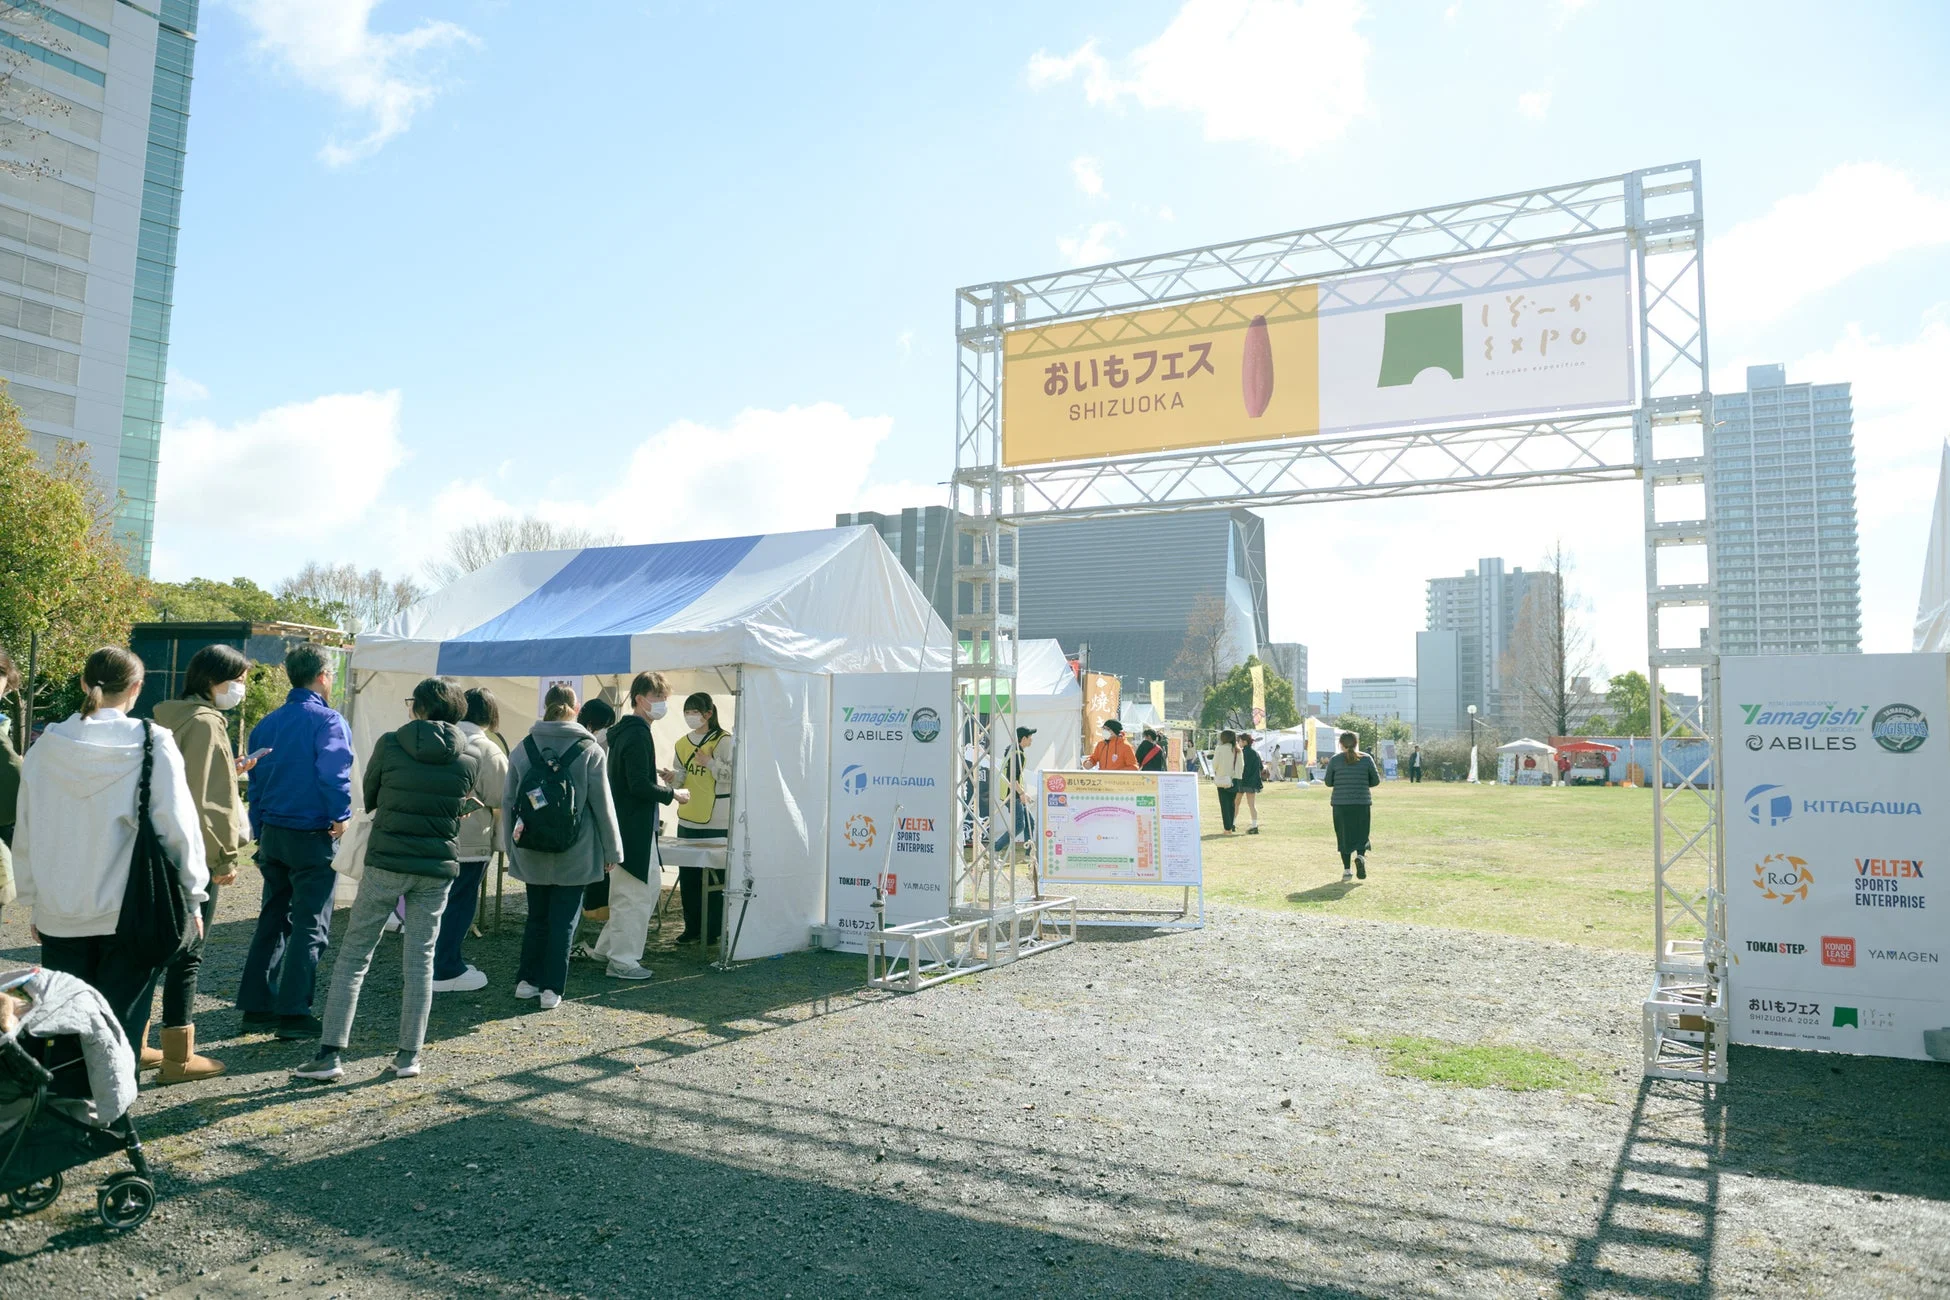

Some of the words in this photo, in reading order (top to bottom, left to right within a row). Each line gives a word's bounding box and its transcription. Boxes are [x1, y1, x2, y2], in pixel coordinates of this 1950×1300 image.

[1044, 342, 1214, 396] おいもフェス
[1069, 391, 1184, 421] SHIZUOKA
[842, 707, 911, 726] Yamagishi
[1740, 704, 1870, 730] Yamagishi
[856, 730, 903, 741] ABILES
[1871, 721, 1929, 738] LOGISTERS
[1769, 737, 1857, 750] ABILES
[686, 763, 707, 777] AFF
[873, 776, 935, 787] KITAGAWA
[1067, 778, 1102, 786] おいもフェス
[1803, 800, 1922, 815] KITAGAWA
[897, 832, 920, 841] SPORTS
[897, 842, 934, 853] ENTERPRISE
[1768, 872, 1798, 886] R&O
[1855, 878, 1898, 892] SPORTS
[903, 882, 940, 892] YAMAGEN
[1855, 893, 1926, 909] ENTERPRISE
[1824, 942, 1851, 951] KONDO
[1826, 950, 1851, 958] LEASE
[1868, 949, 1939, 963] YAMAGEN
[1748, 998, 1820, 1015] おいもフェス
[1750, 1013, 1794, 1023] SHIZUOKA
[1797, 1017, 1819, 1025] 2024
